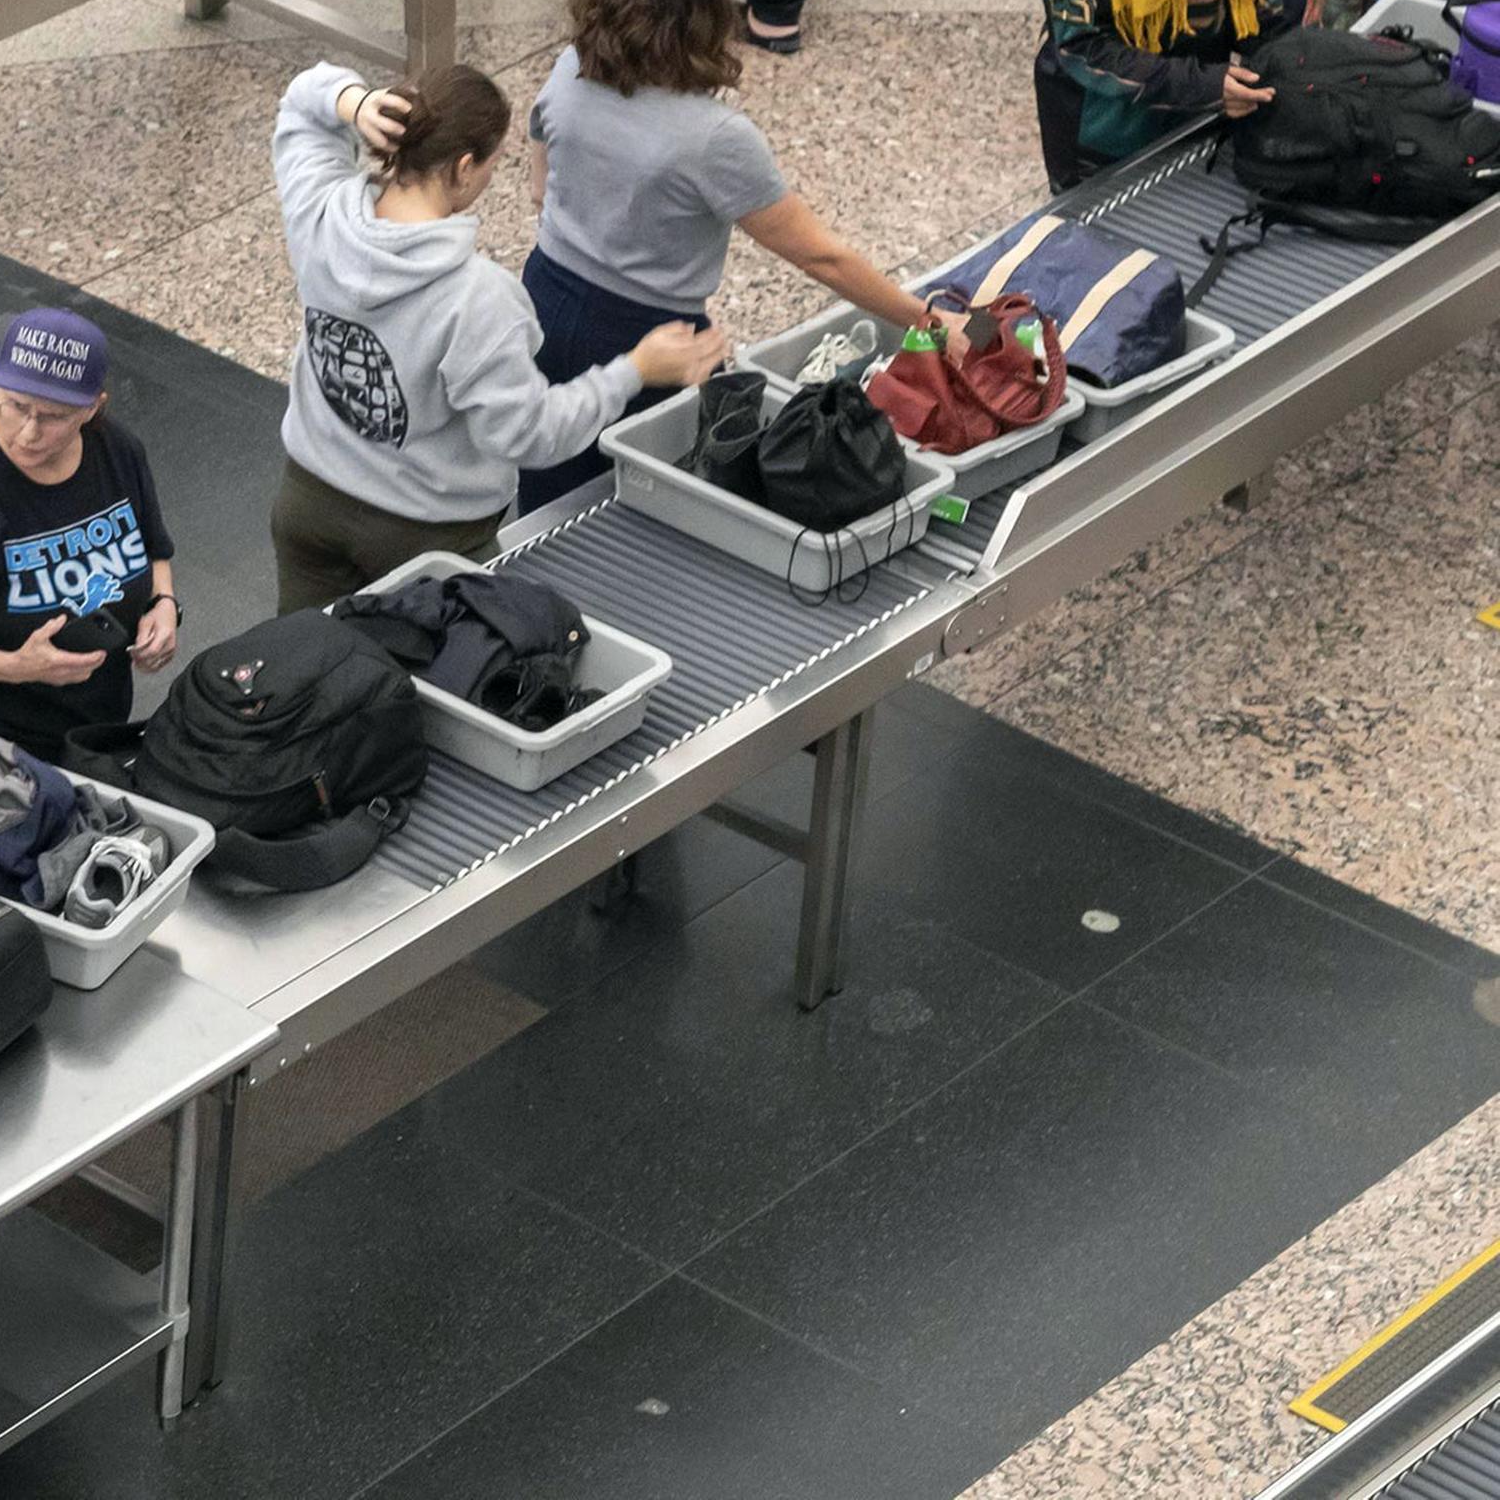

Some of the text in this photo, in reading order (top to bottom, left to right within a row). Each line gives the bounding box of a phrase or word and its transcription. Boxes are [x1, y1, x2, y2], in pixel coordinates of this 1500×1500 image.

[10, 345, 86, 381] WRONG AGAIN
[16, 325, 90, 362] MAKE RACISM
[4, 503, 138, 572] DETROIT
[8, 529, 148, 608] LIONS
